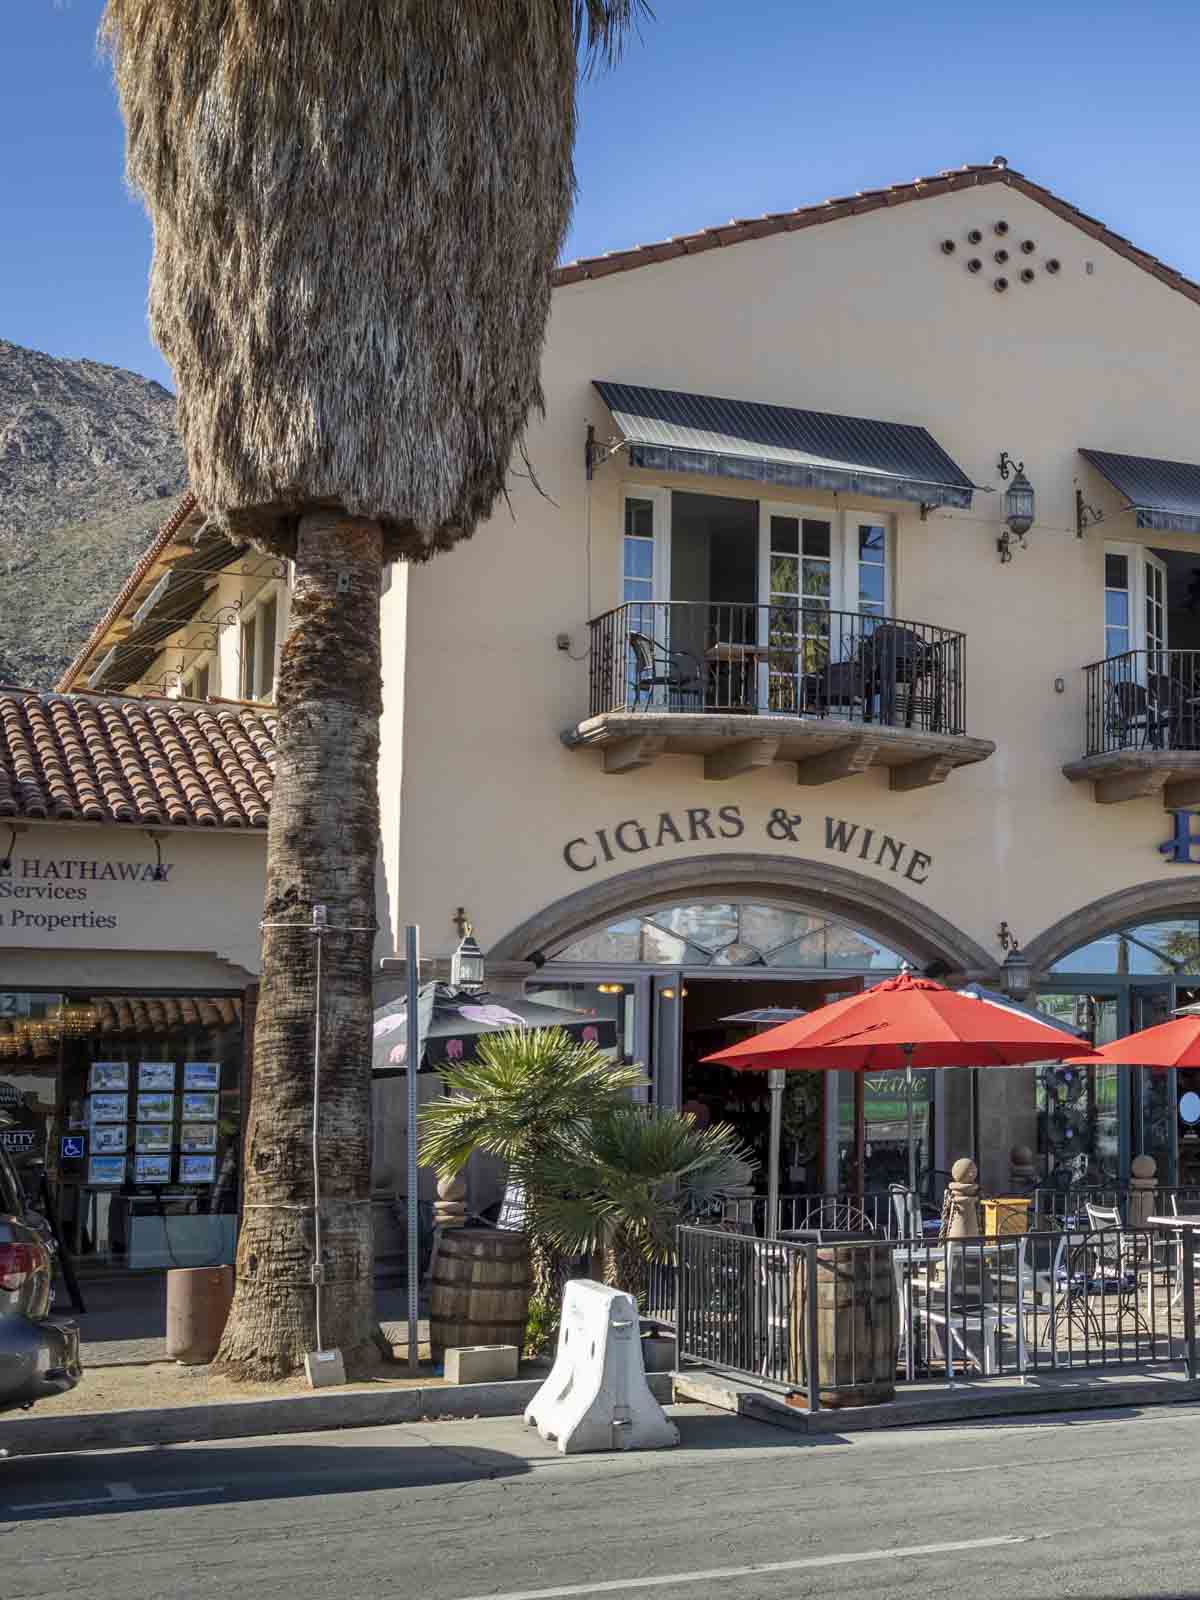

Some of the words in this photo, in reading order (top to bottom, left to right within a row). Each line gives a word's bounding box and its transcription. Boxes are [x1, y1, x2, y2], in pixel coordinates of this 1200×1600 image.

[563, 805, 746, 872] CIGARS
[765, 808, 803, 842] &
[824, 815, 932, 885] WINE
[21, 859, 175, 881] HATHAWAY
[0, 880, 87, 900] Services
[10, 909, 118, 931] Properties
